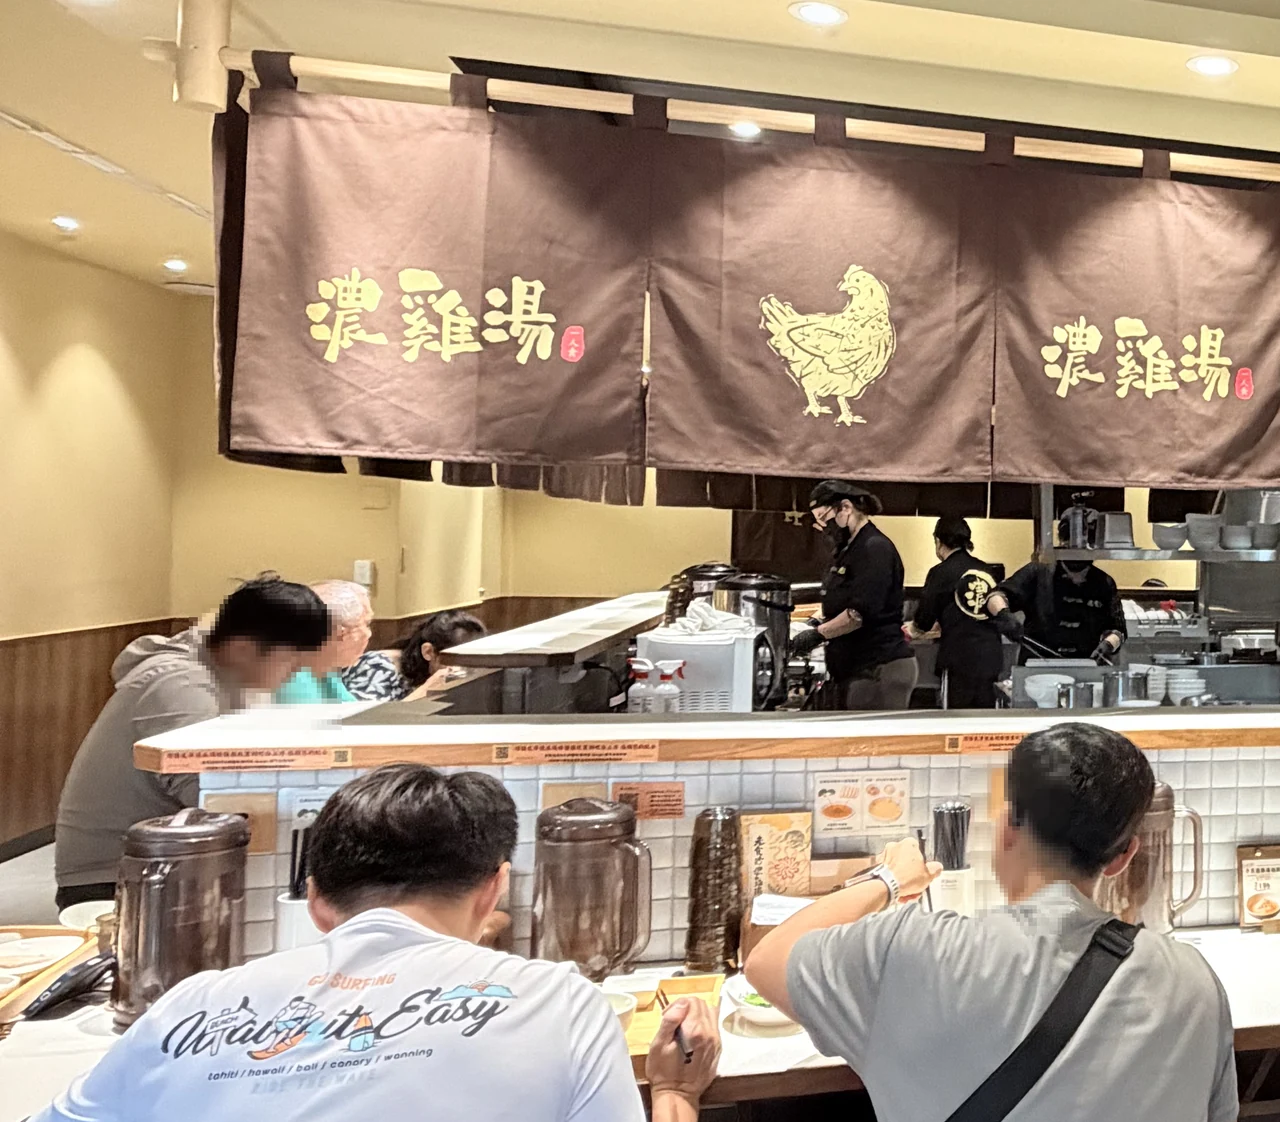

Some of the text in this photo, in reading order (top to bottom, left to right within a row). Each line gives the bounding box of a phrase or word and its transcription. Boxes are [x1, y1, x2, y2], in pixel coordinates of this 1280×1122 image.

[305, 266, 557, 365] 濃雞湯
[1041, 315, 1233, 401] 濃雞湯
[329, 971, 397, 991] SURFING
[374, 986, 509, 1037] Easy
[206, 1068, 240, 1081] tahiti
[247, 1065, 286, 1077] hawaii
[295, 1061, 318, 1073] bali
[330, 1057, 372, 1069] canary
[383, 1048, 434, 1062] wanning
